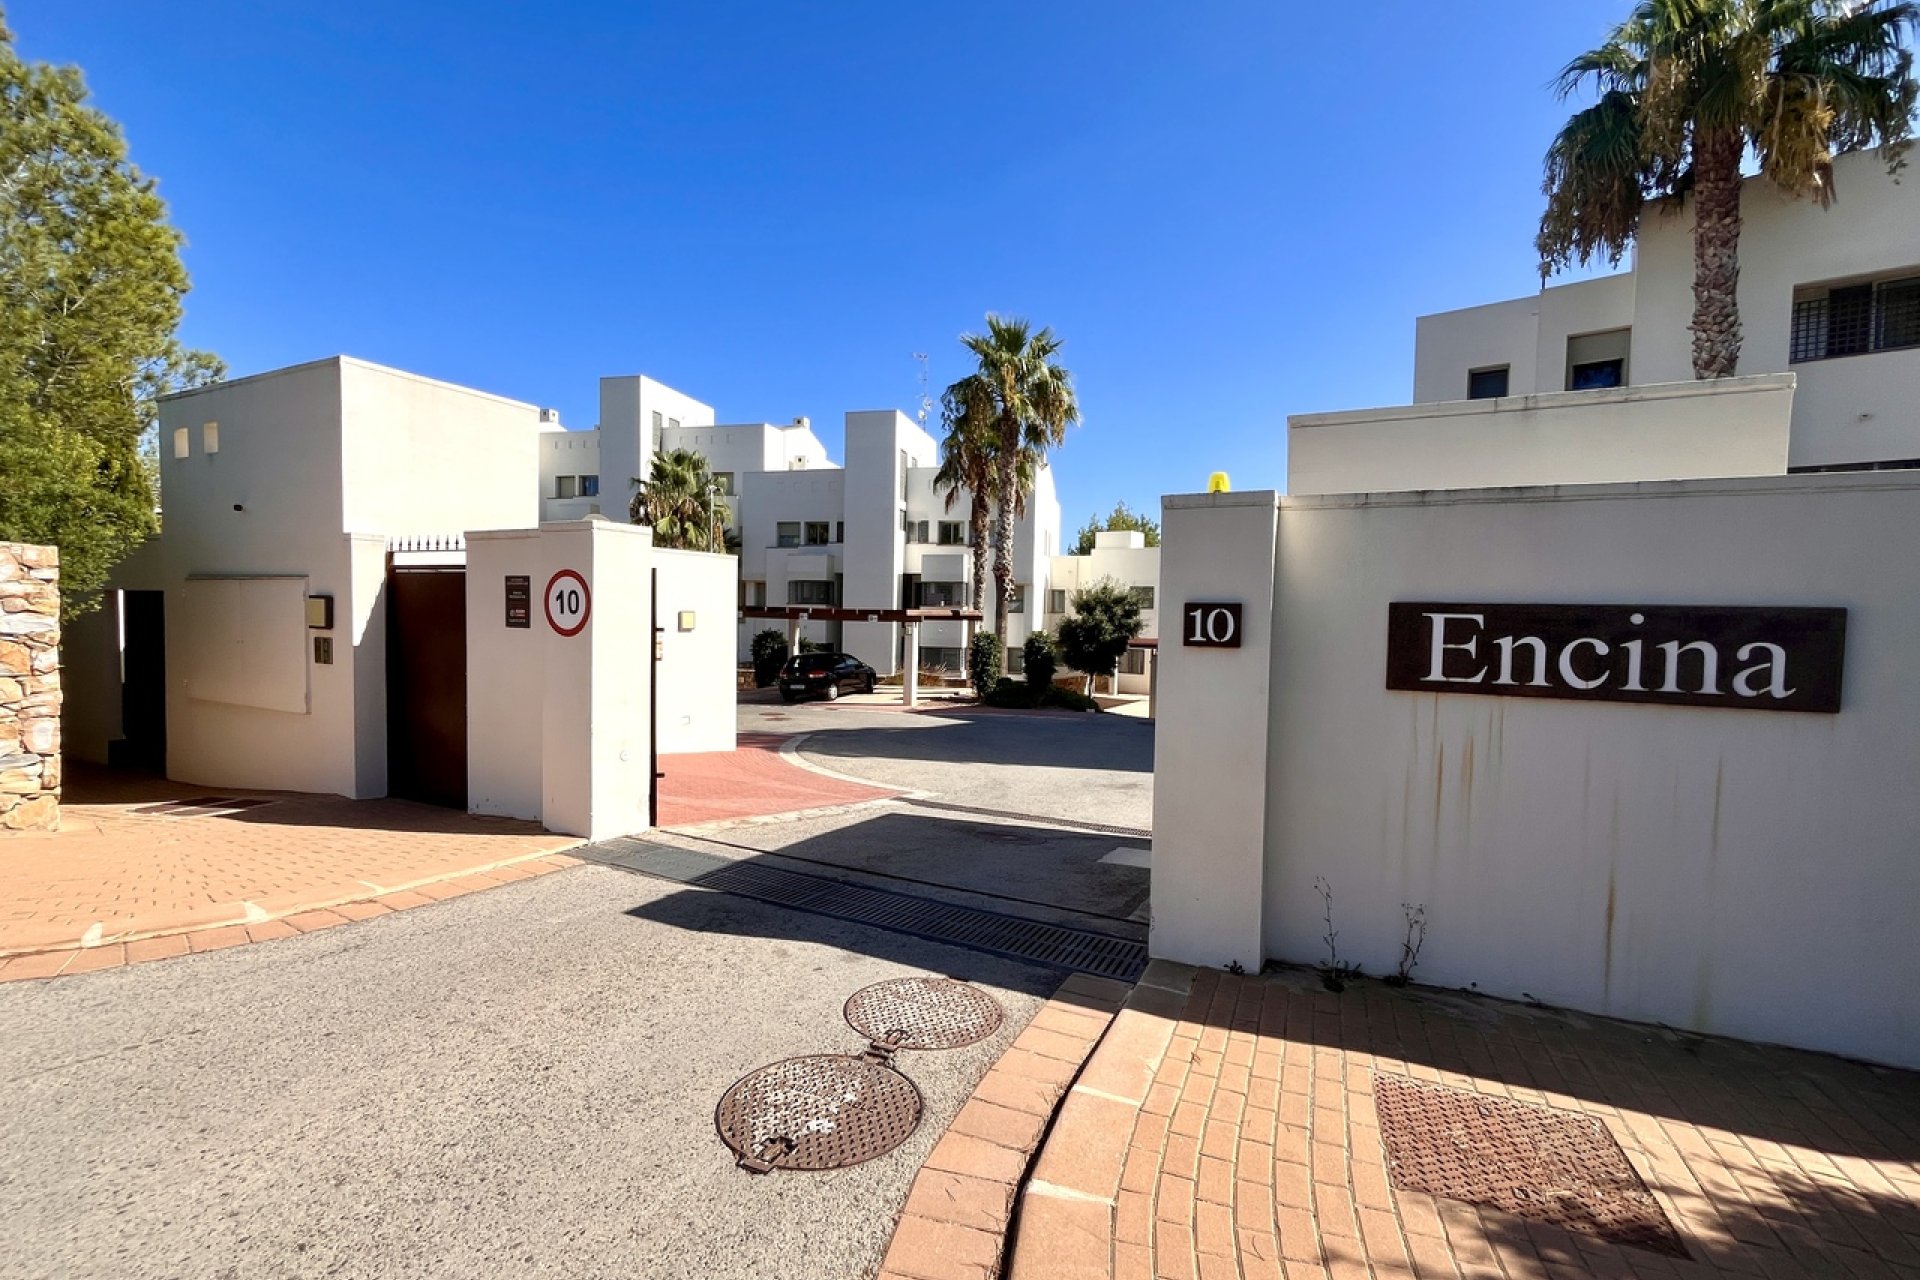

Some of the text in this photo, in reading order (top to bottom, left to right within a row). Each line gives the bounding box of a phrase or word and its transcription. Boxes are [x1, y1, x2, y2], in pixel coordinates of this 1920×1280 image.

[556, 589, 580, 615] 10
[1189, 608, 1234, 642] 10
[1419, 612, 1797, 698] Encina
